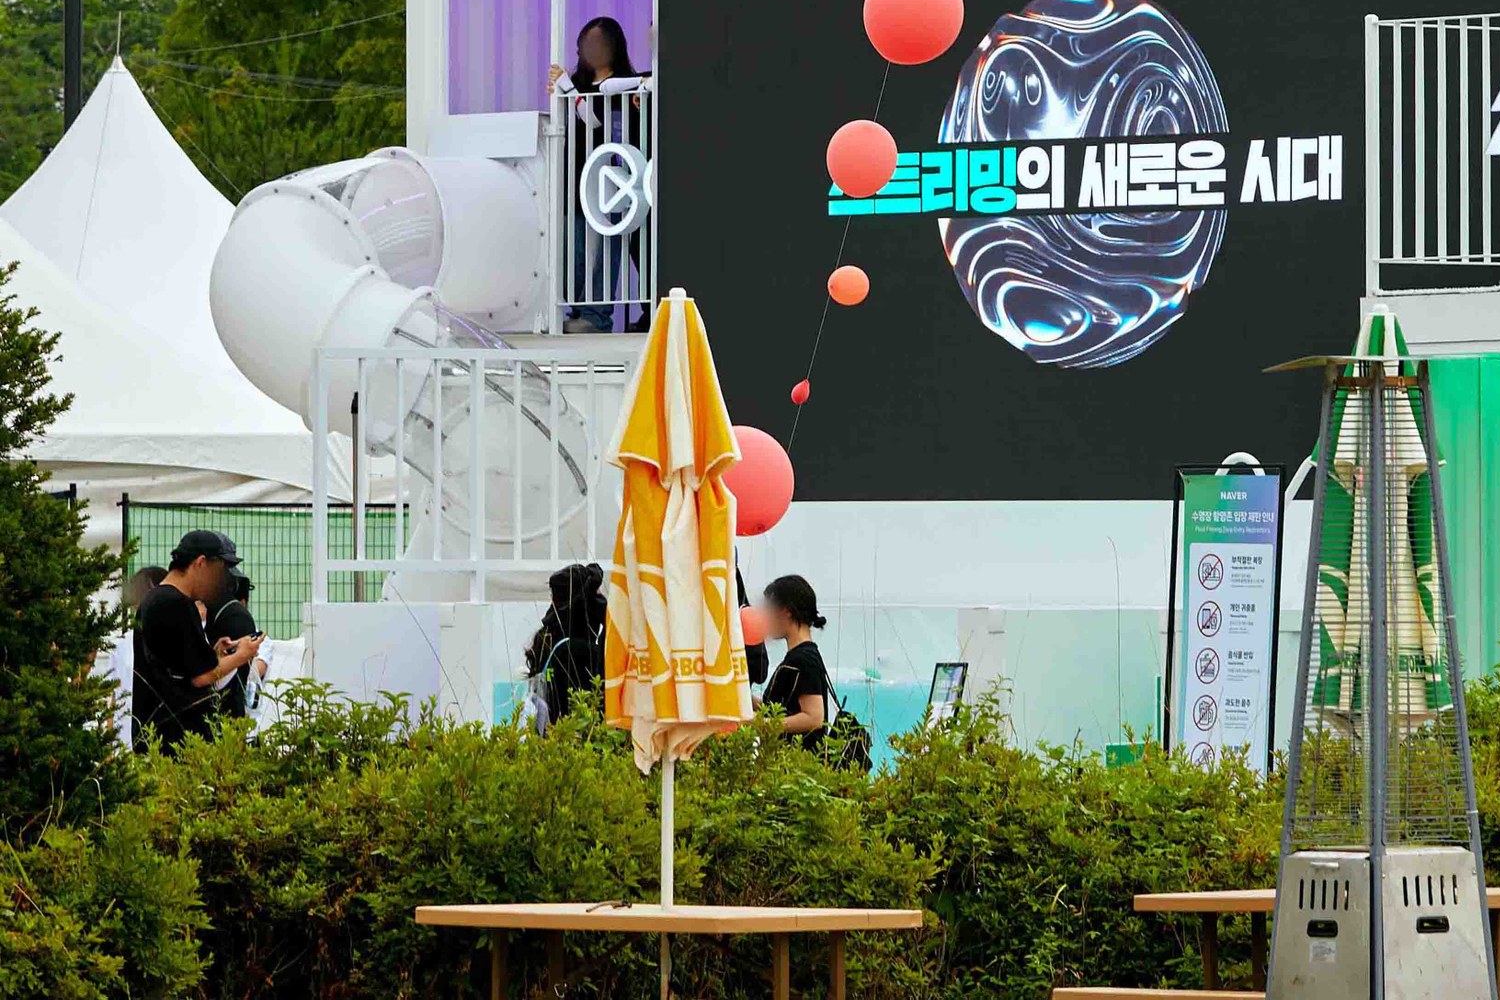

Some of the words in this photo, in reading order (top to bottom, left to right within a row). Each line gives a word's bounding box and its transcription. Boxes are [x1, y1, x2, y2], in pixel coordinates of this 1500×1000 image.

[1077, 139, 1226, 208] 새로운
[1239, 135, 1343, 203] 시대
[1220, 491, 1248, 501] NAVER
[1191, 510, 1212, 523] 수영장
[1233, 511, 1248, 523] 입장
[1262, 511, 1275, 523] 안내
